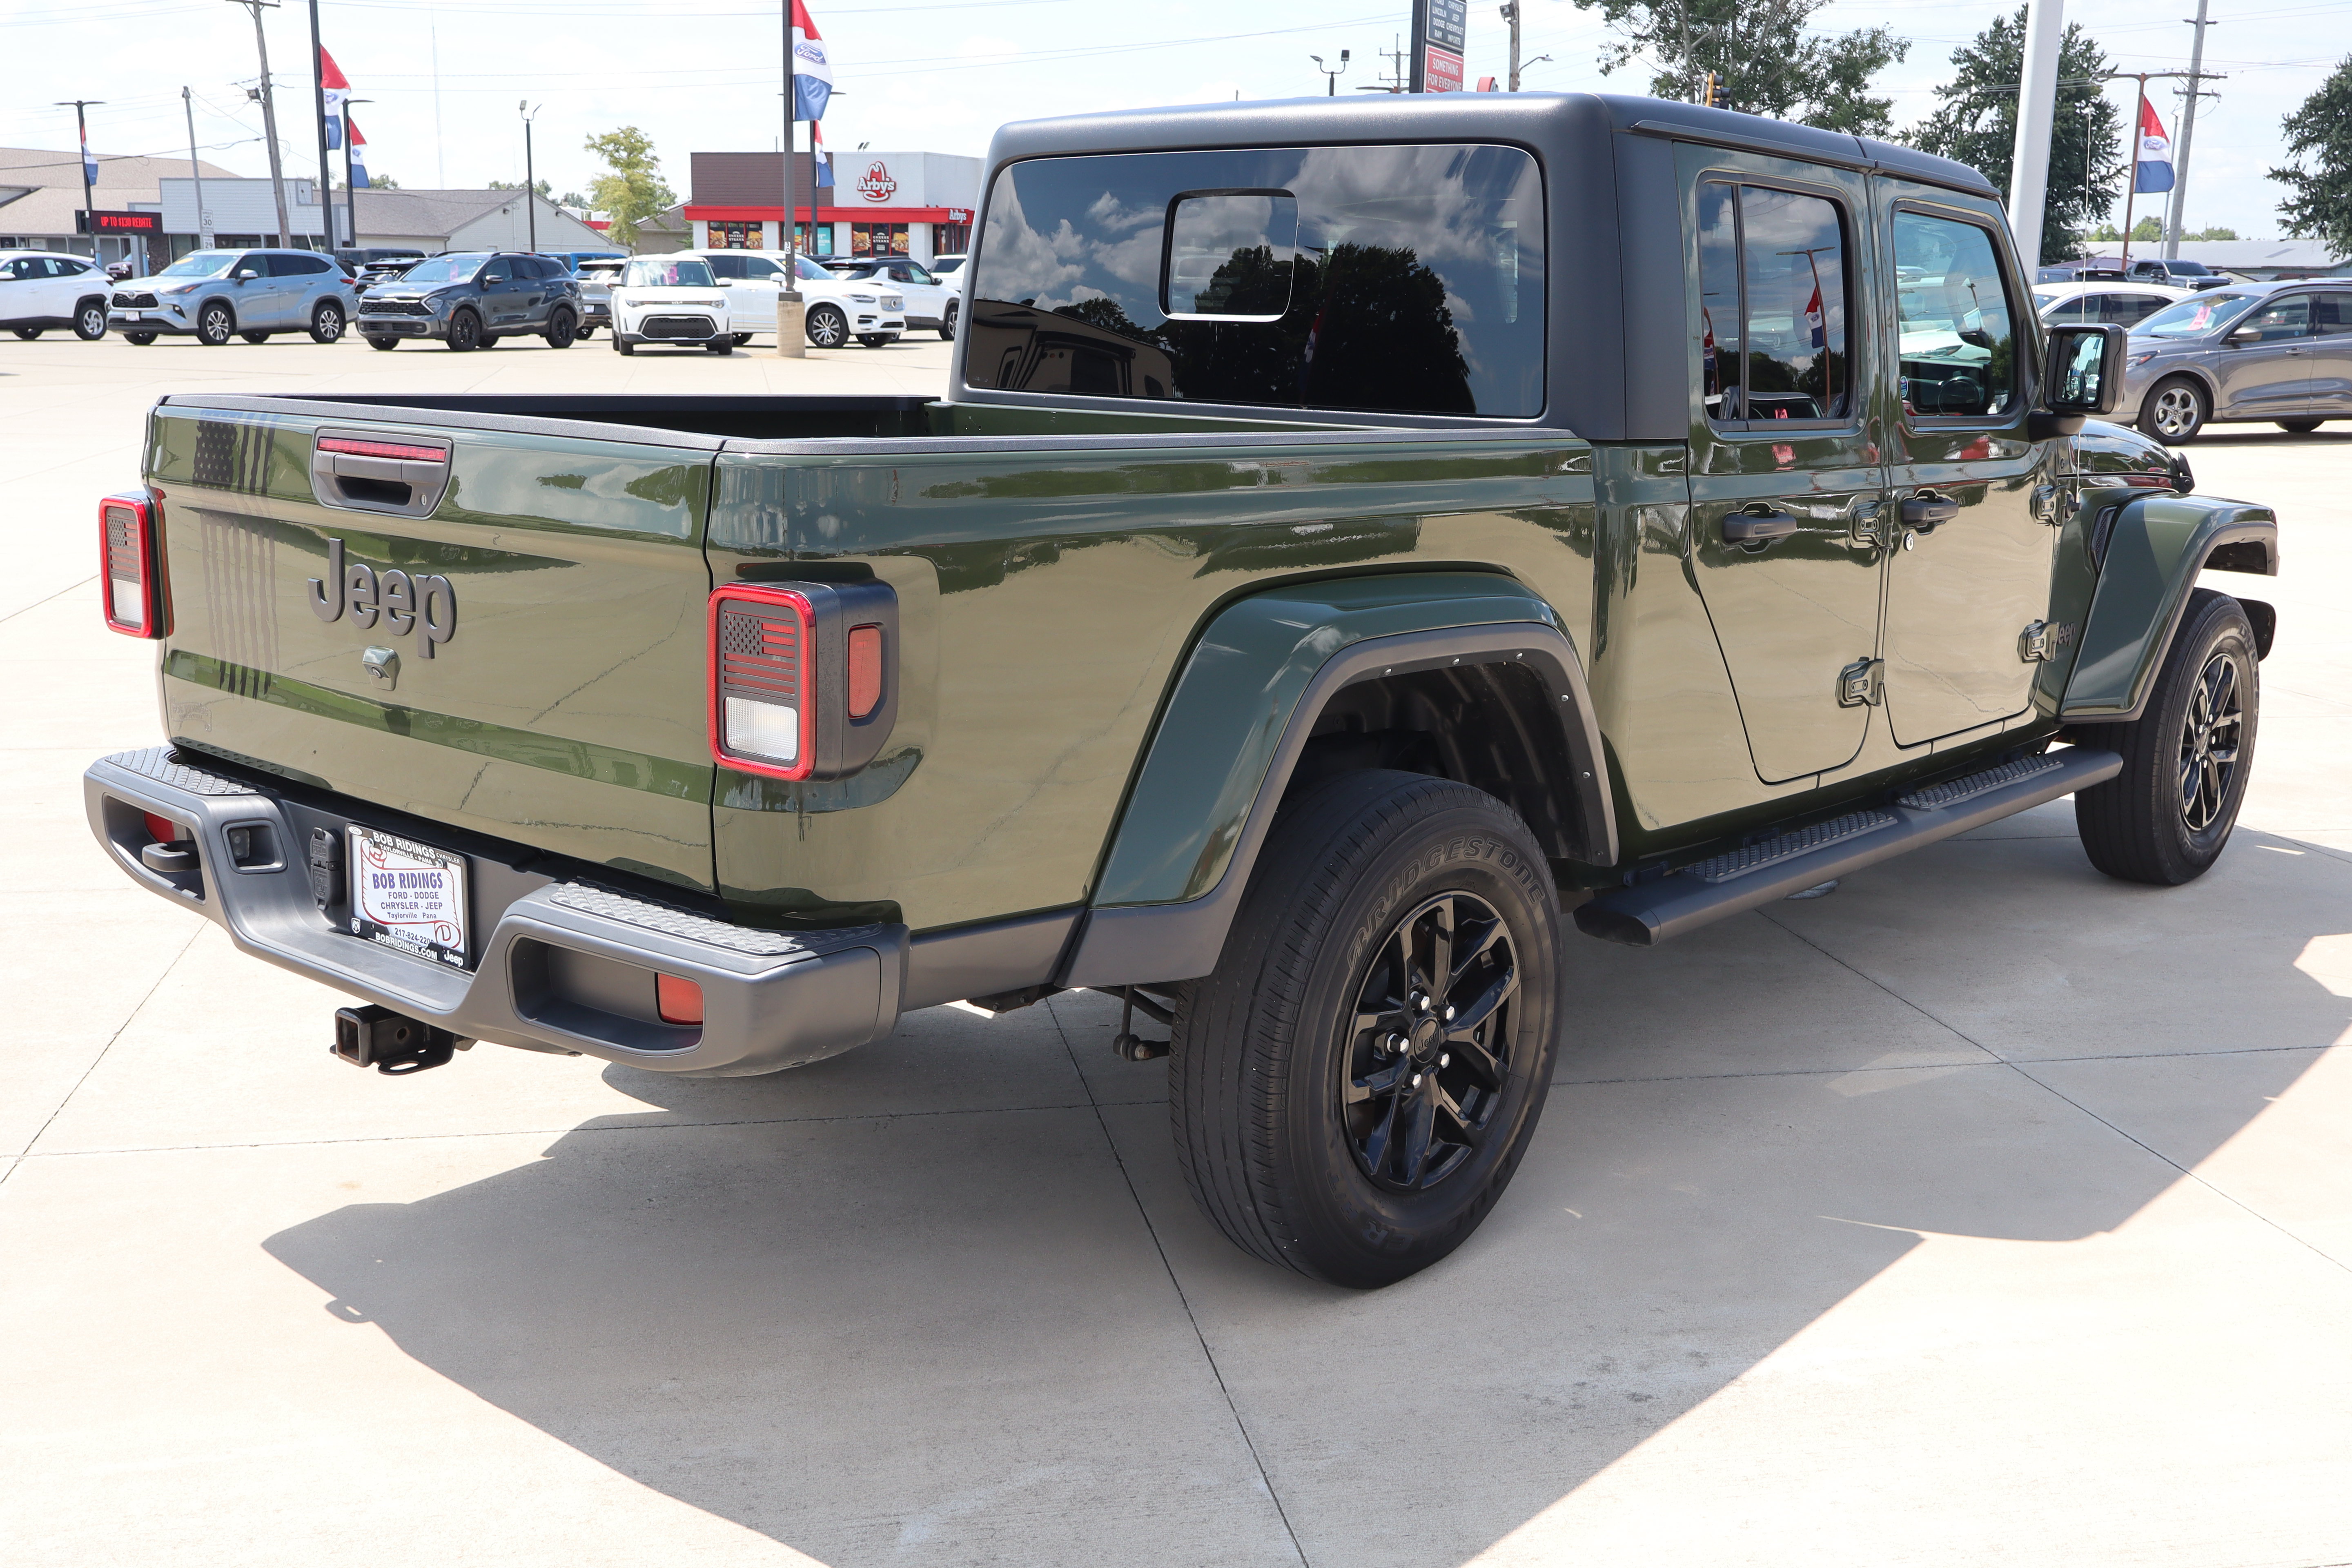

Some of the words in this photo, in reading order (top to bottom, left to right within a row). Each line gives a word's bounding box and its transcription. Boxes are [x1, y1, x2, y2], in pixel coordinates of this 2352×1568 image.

[1432, 6, 1446, 18] LINCOLN
[1448, 1, 1463, 13] CHRYSLER
[1433, 17, 1445, 29] DODGE
[1446, 22, 1463, 35] CHEVROLET
[1448, 34, 1461, 45] IMPORTS
[797, 45, 823, 62] Ford
[1433, 58, 1458, 76] SOMETHING
[1428, 73, 1438, 86] FOR
[1439, 76, 1461, 91] EVERYONE
[2145, 140, 2161, 149] Ford
[858, 177, 895, 194] Arby's
[101, 216, 109, 226] UP
[110, 217, 117, 227] TO
[118, 217, 131, 227] $130
[132, 217, 152, 227] REBATE
[949, 209, 967, 223] Arby's
[308, 538, 457, 659] Jeep
[2058, 622, 2076, 647] eep
[373, 832, 394, 846] BOB
[395, 838, 436, 859] RIDINGS
[379, 844, 414, 859] TAYLORVILLE
[419, 856, 433, 865] PANA
[437, 853, 461, 864] CHRYSLER
[372, 873, 395, 889] BOB
[399, 872, 443, 889] RIDINGS
[1347, 835, 1546, 971] BRIDGESTONE
[376, 932, 437, 960] BOBRIDINGS.COM
[444, 950, 463, 967] Jeep
[1418, 1031, 1437, 1051] Jeep
